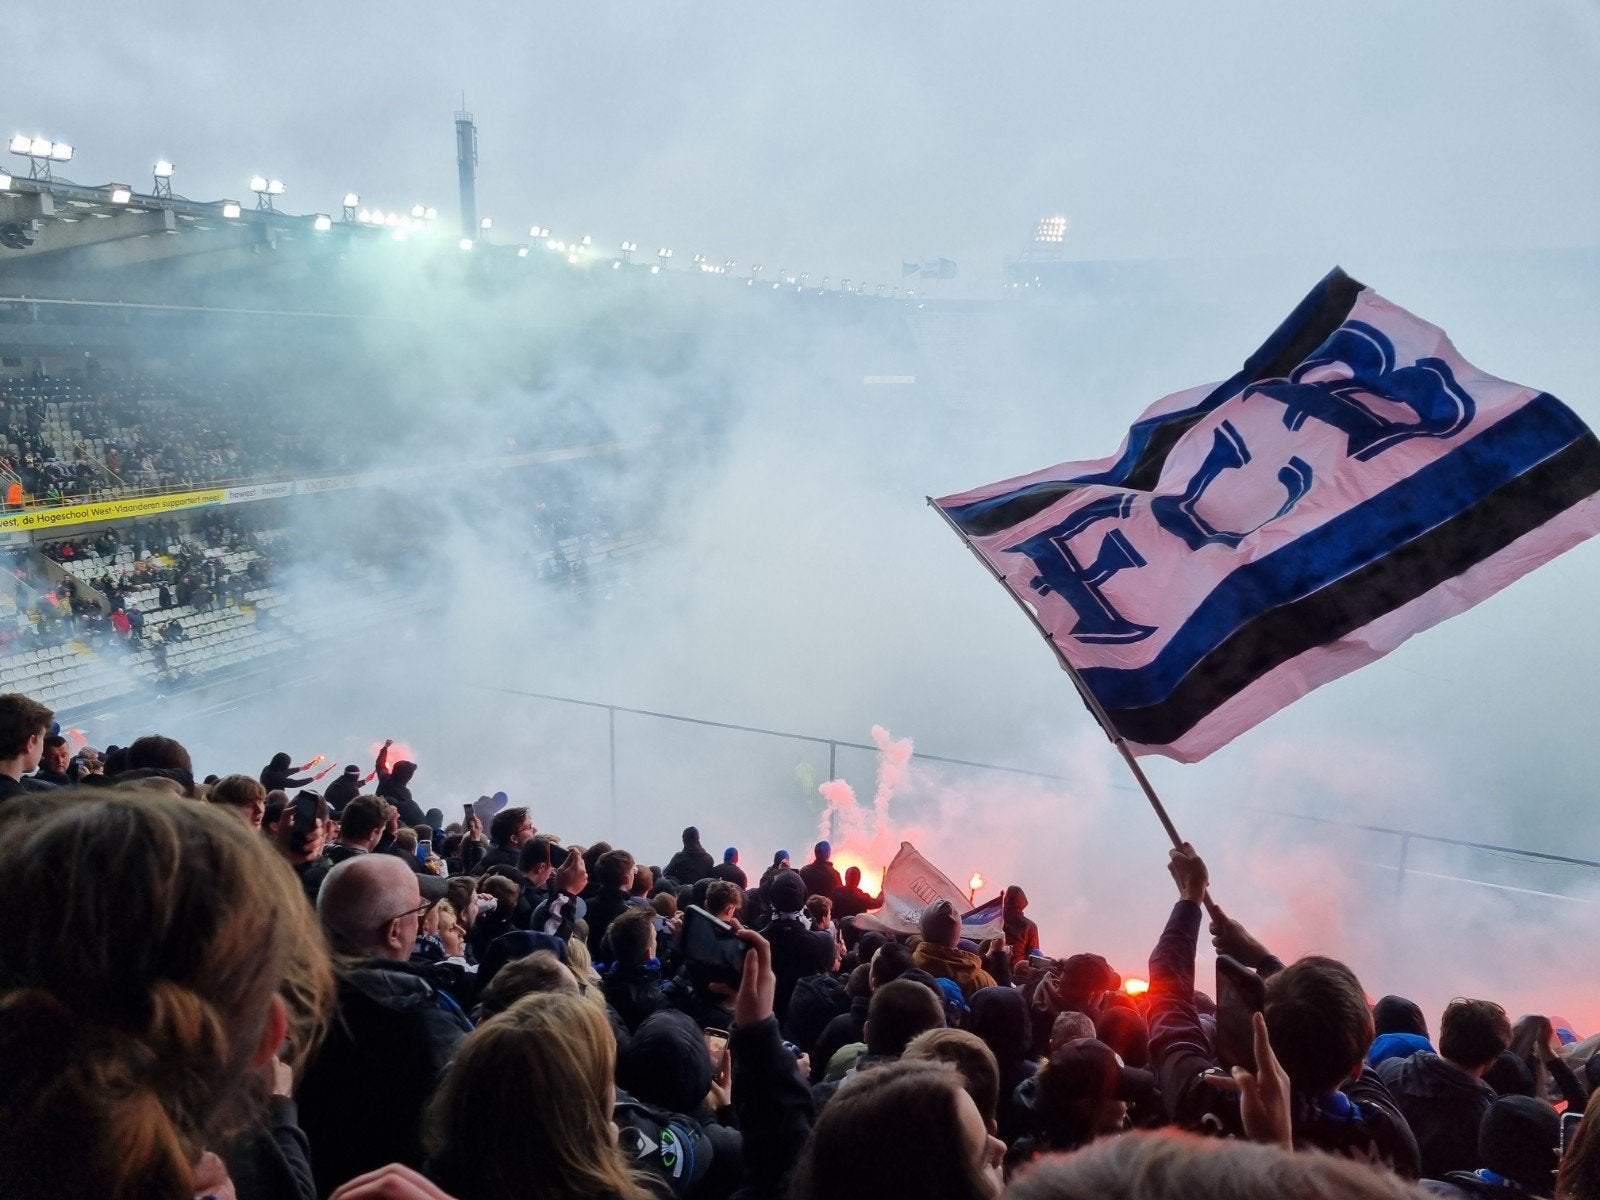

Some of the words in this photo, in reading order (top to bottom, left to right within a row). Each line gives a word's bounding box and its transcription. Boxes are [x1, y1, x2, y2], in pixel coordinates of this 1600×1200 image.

[229, 489, 257, 499] howest
[1000, 319, 1477, 645] FCB
[22, 515, 34, 525] de
[37, 510, 89, 523] Hogeschool
[91, 501, 160, 516] West-Vlaanderen
[162, 495, 201, 508] supportert
